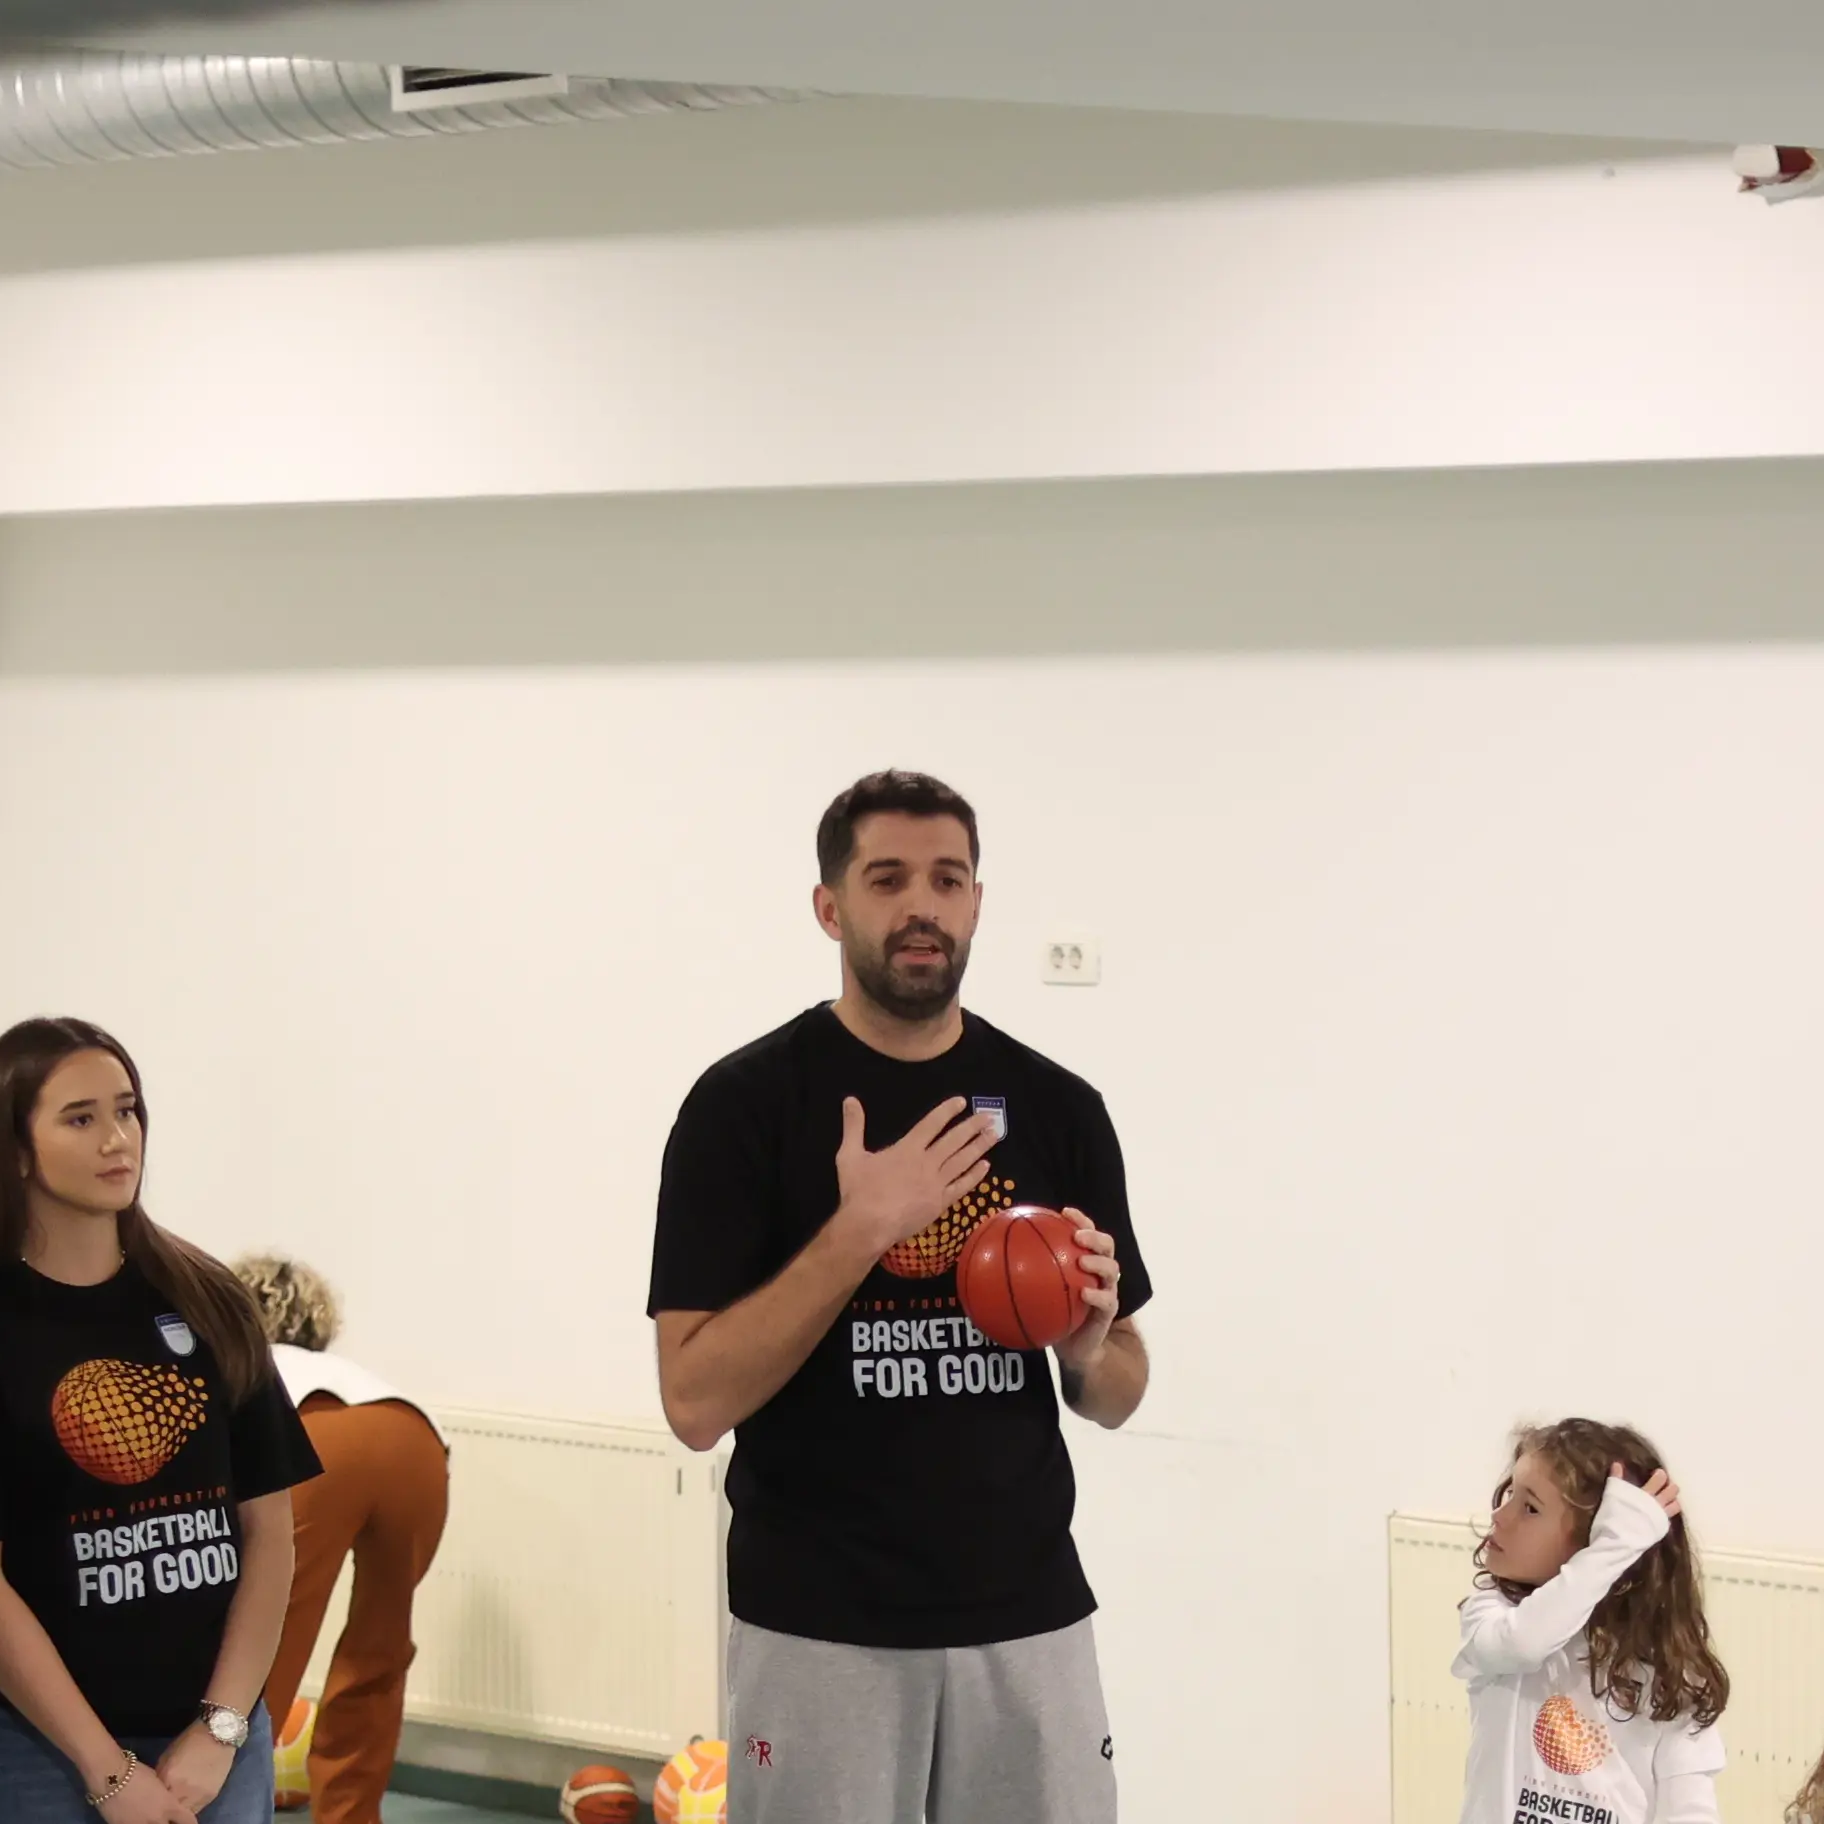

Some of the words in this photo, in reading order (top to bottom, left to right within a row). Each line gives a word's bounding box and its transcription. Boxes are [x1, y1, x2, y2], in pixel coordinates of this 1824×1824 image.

[852, 1316, 1000, 1352] BASKETB
[852, 1357, 928, 1398] FOR
[938, 1352, 1025, 1395] GOOD
[73, 1506, 232, 1561] BASKETBALL
[78, 1560, 145, 1607] FOR
[152, 1542, 239, 1594] GOOD
